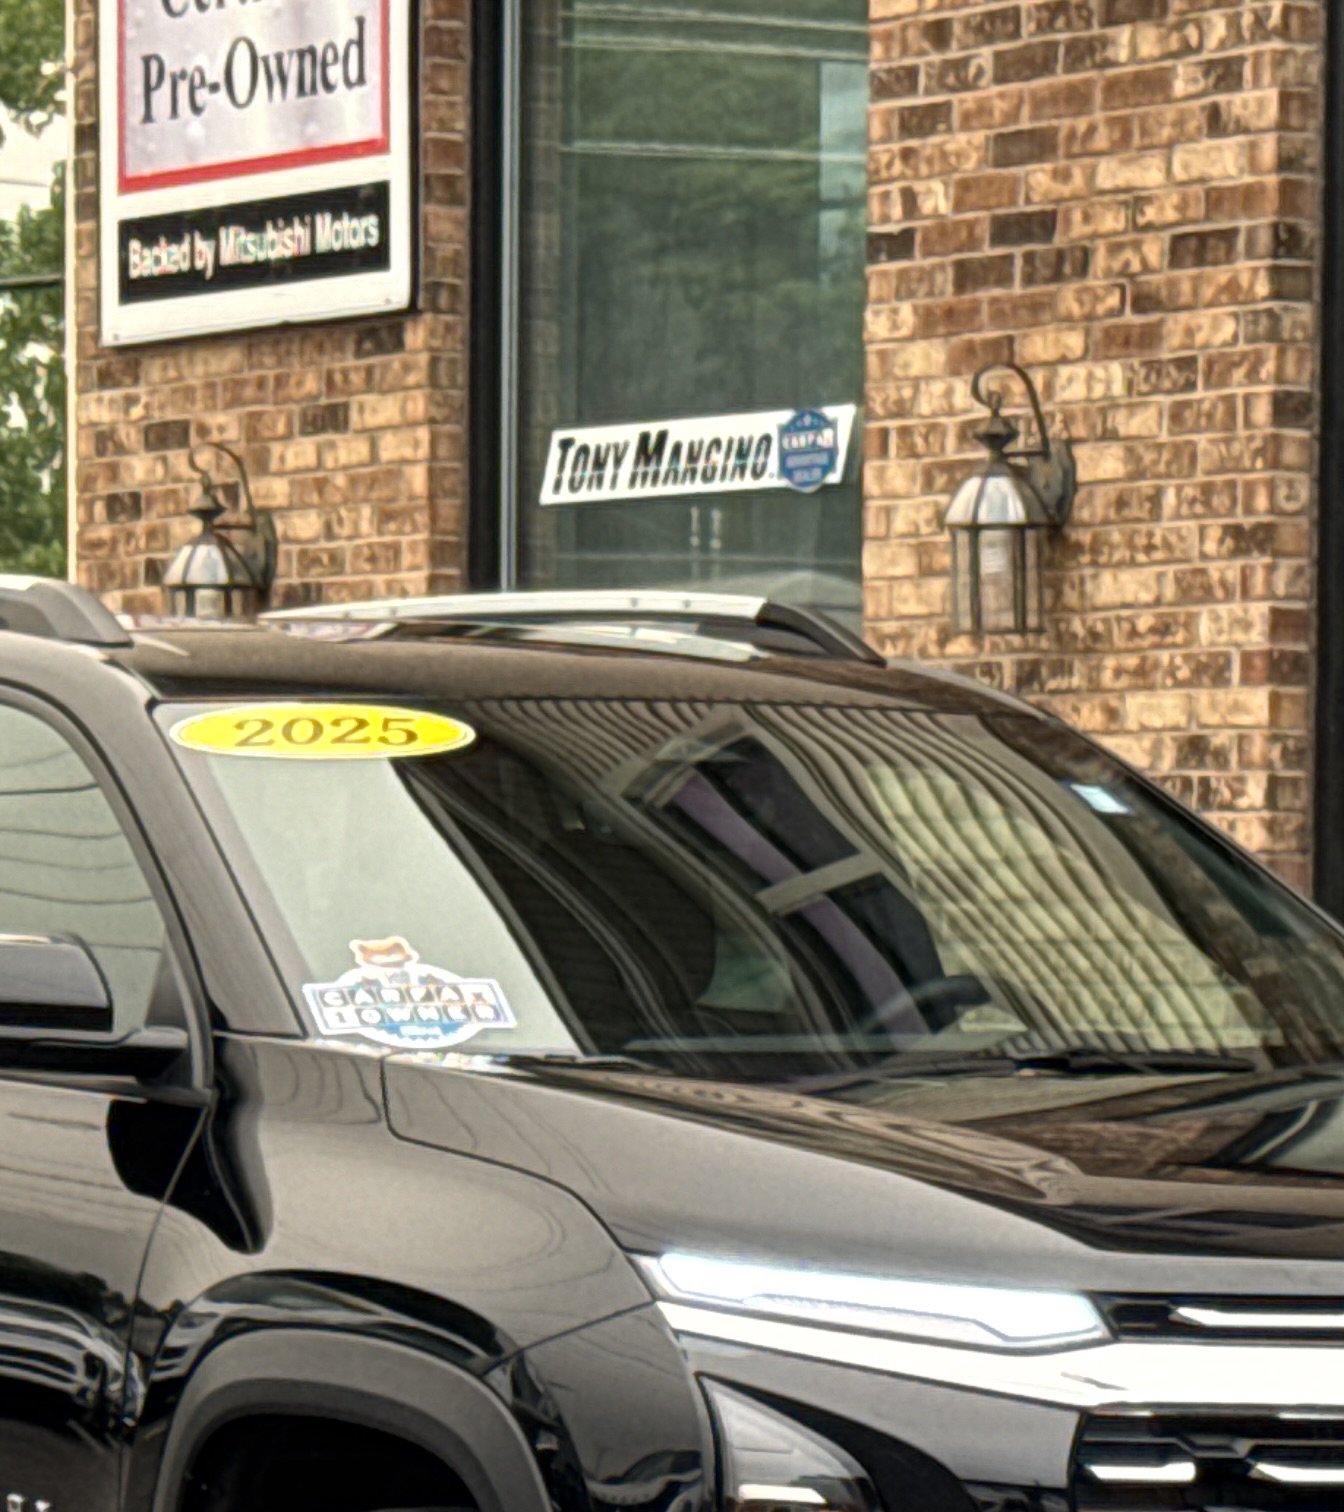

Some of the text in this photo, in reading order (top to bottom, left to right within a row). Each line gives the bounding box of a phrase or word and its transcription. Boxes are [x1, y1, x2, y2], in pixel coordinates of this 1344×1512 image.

[141, 16, 366, 124] Pre-Owned
[128, 211, 379, 280] Backed by Mitsubishi Motors
[553, 429, 773, 495] TONY MANGINO
[233, 716, 419, 748] 2025
[320, 985, 490, 1006] CARFAX
